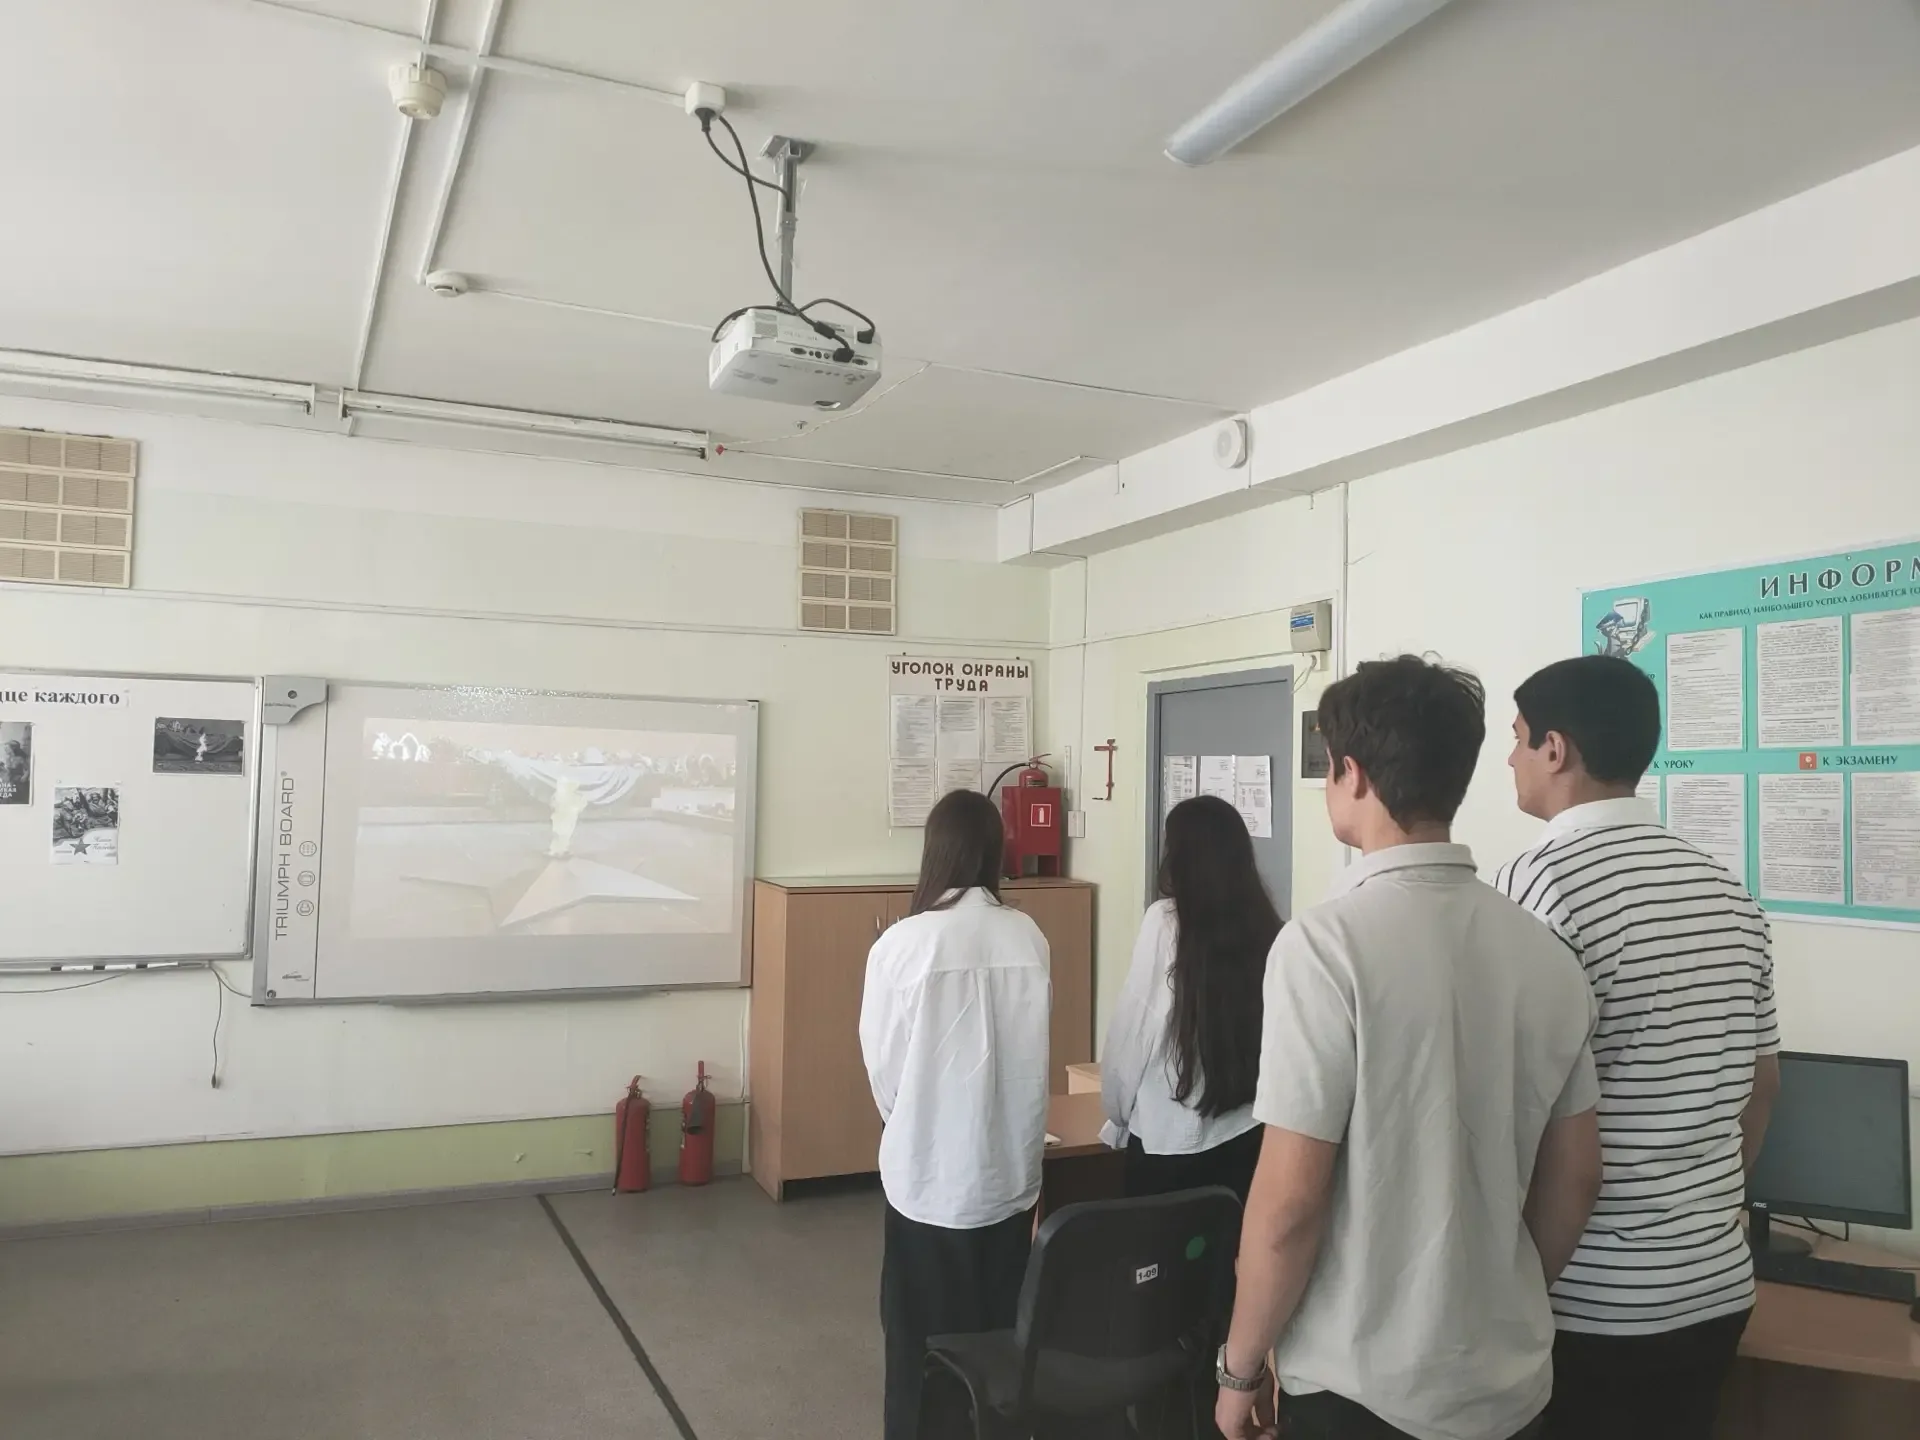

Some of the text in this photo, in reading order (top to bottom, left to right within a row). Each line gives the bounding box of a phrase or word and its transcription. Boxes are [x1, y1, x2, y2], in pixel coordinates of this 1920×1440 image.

[1699, 612, 1713, 620] КАК
[1753, 600, 1813, 613] НАИБОЛЬШЕГО
[1815, 596, 1847, 606] УСПЕХА
[1850, 588, 1907, 603] ДОБИВАЕТСЯ
[892, 661, 1028, 679] УГОЛОК ОХРАНЫ
[935, 678, 989, 692] ТРУДА
[0, 691, 120, 705] це каждого
[1653, 759, 1695, 769] К УРОКУ
[1822, 755, 1898, 766] К ЭКЗАМЕНУ
[275, 853, 291, 941] TRIUMPH
[1138, 1267, 1157, 1281] 1-09
